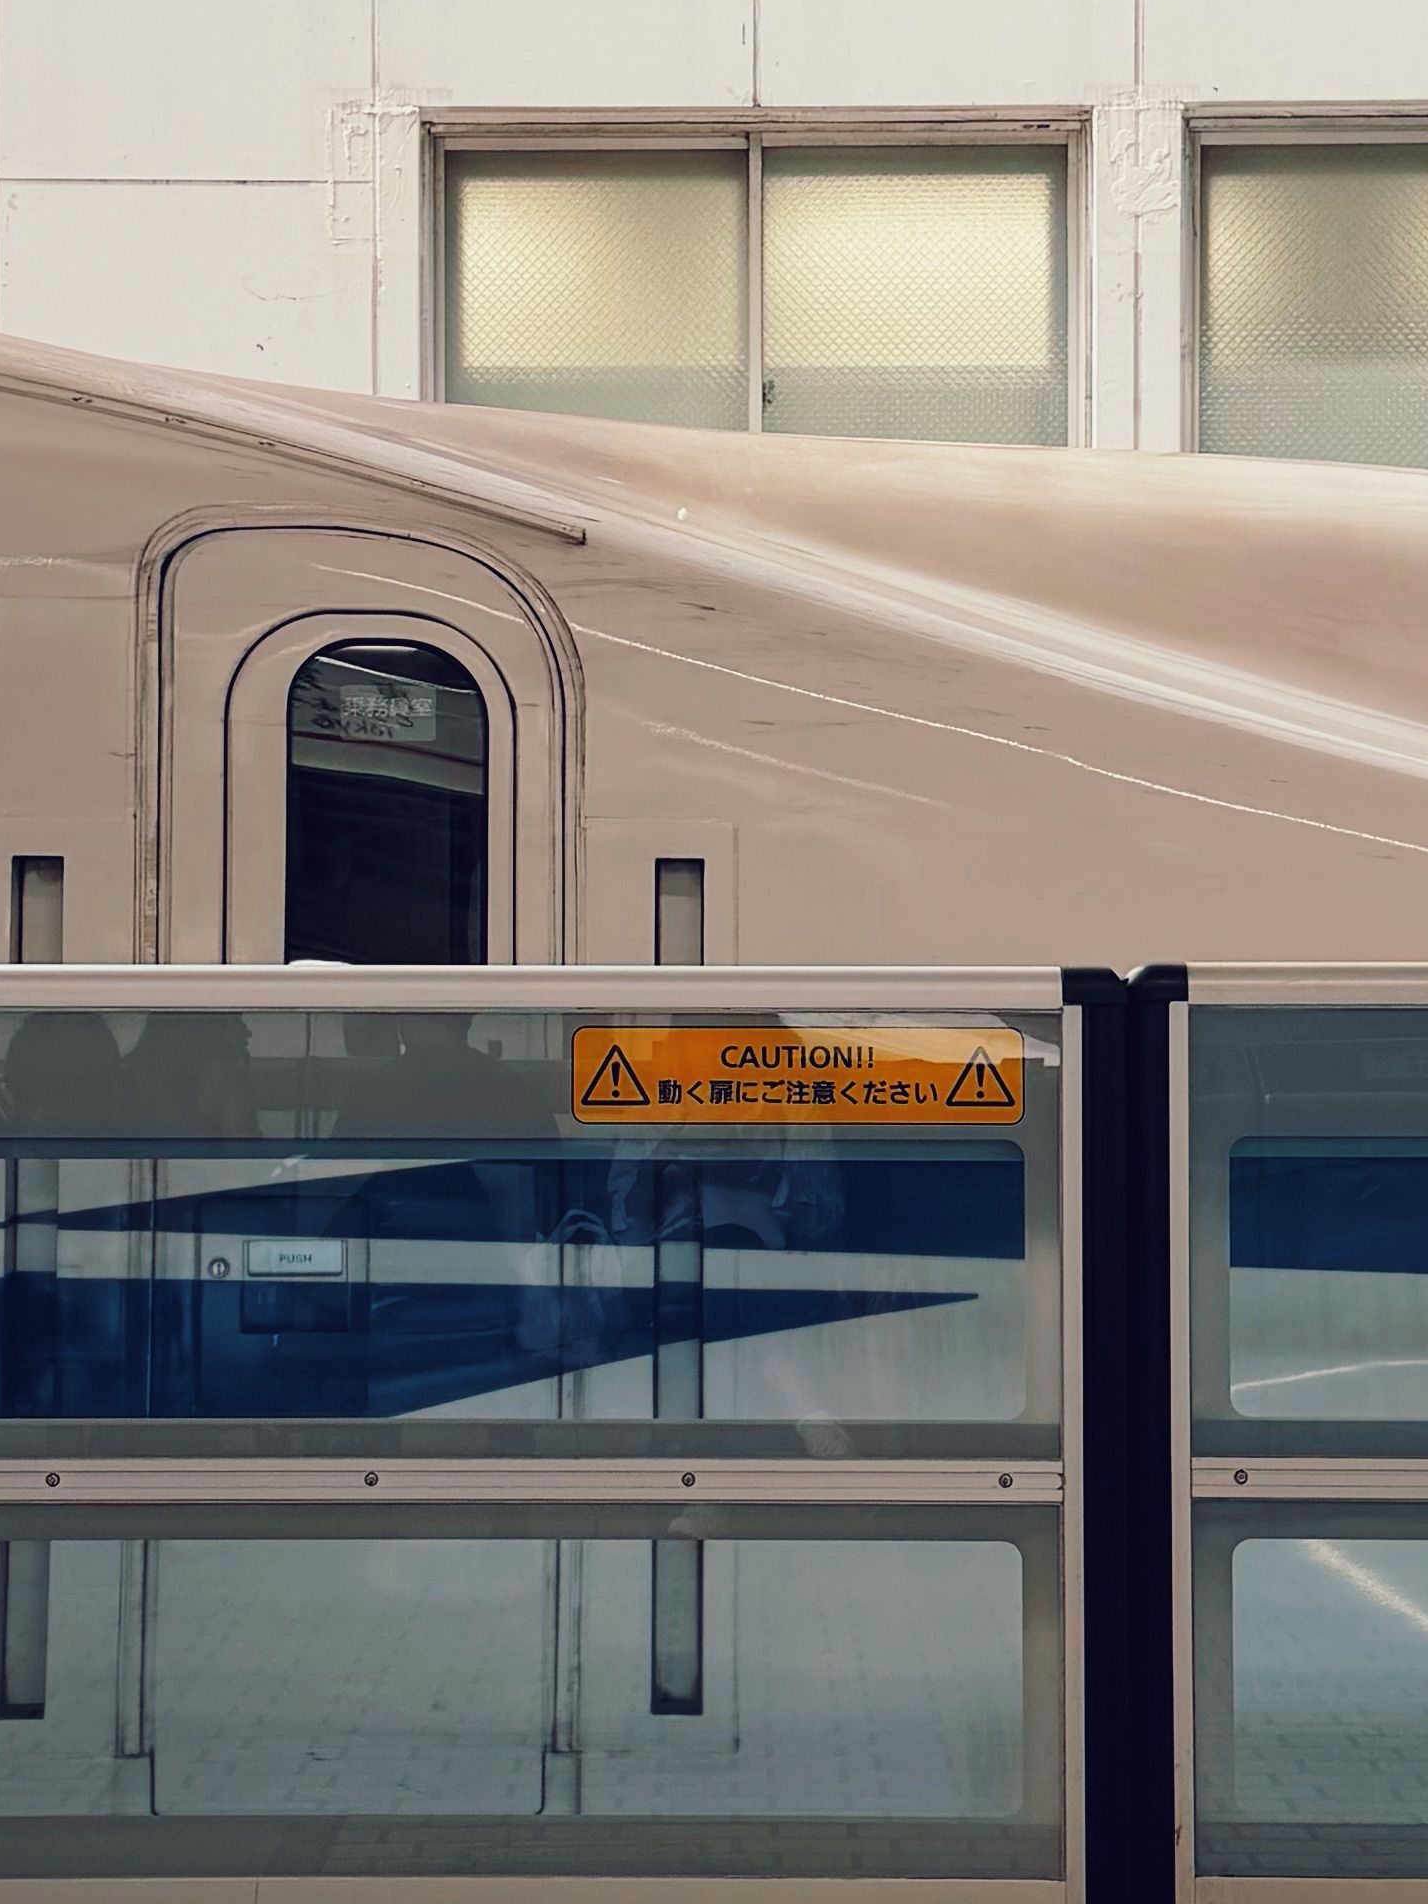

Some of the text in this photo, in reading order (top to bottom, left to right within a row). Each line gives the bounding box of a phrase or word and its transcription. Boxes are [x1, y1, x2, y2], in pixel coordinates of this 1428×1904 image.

[720, 1045, 875, 1070] CAUTION!!
[657, 1080, 939, 1106] 動く扉にご注意ください
[279, 1254, 312, 1264] PUSH
